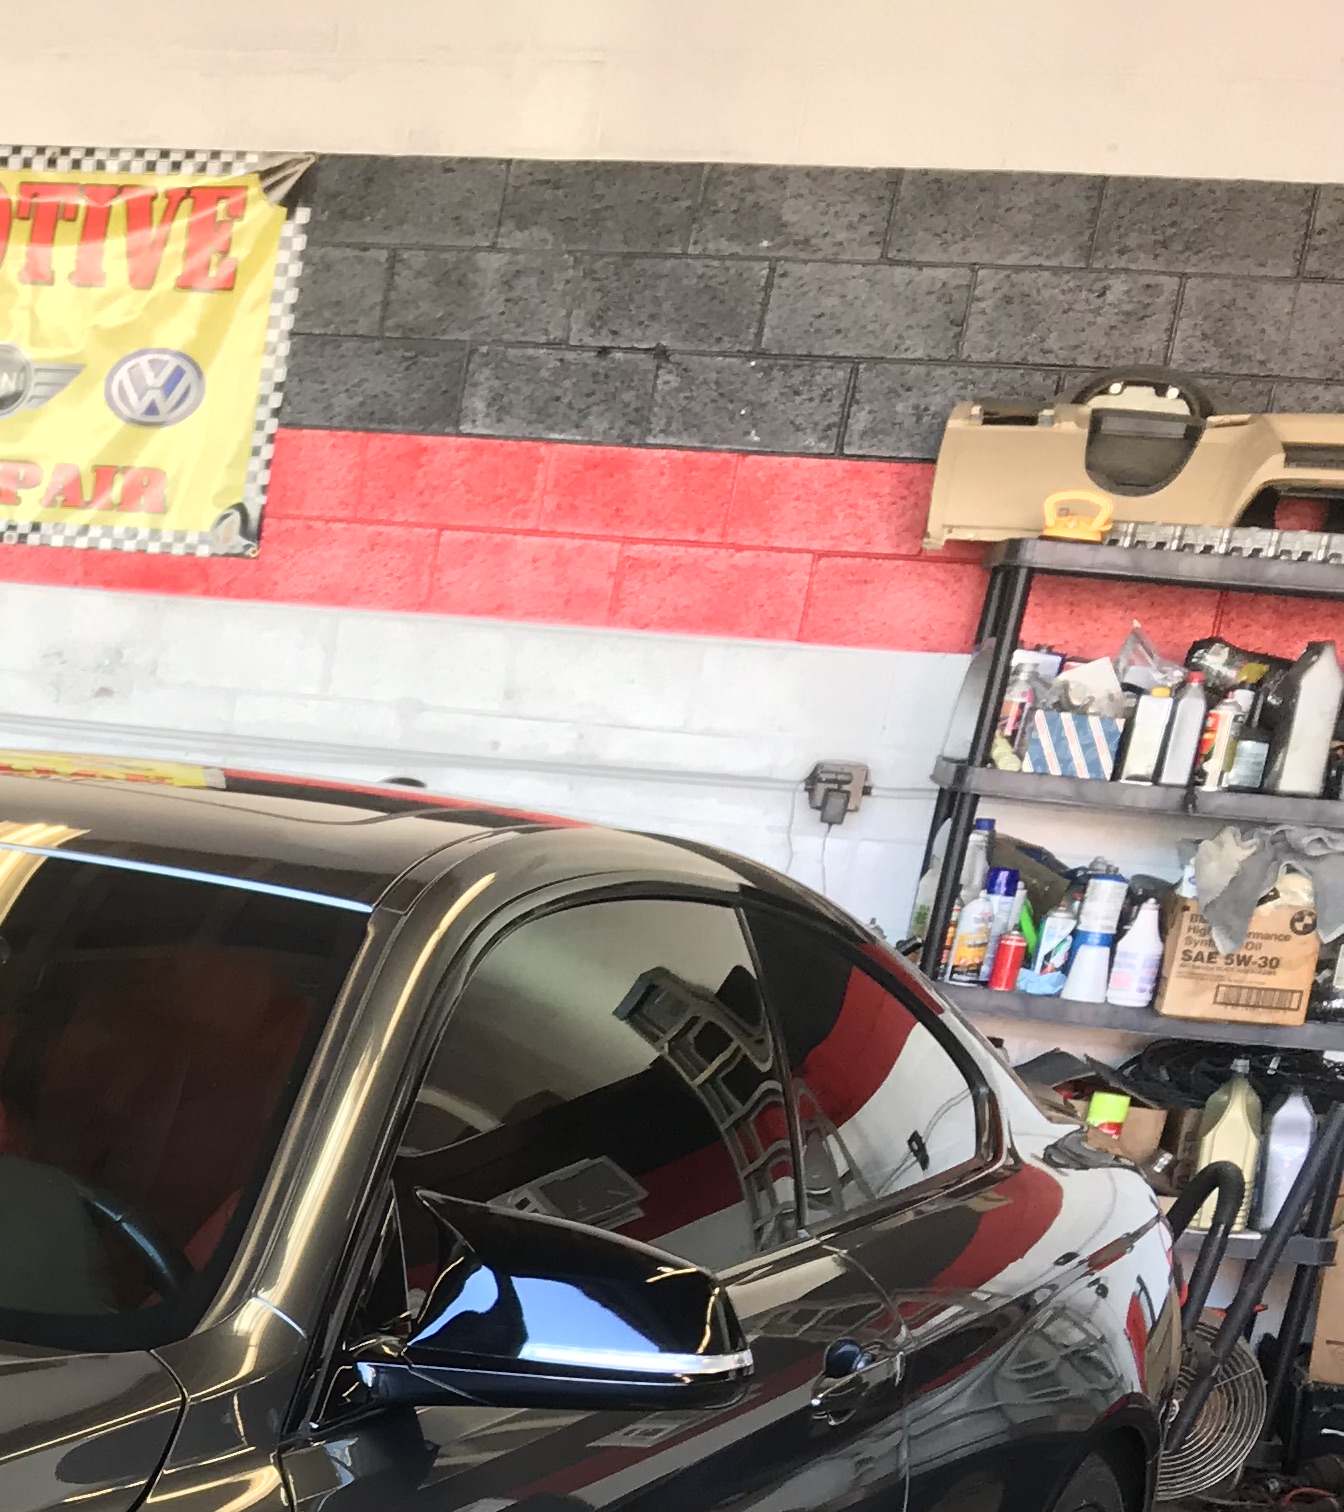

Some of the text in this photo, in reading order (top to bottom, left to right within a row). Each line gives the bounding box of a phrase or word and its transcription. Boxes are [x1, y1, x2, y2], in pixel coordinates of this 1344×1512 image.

[1246, 931, 1292, 942] rmance
[1181, 949, 1219, 964] SAE
[1223, 952, 1281, 970] 5W-30
